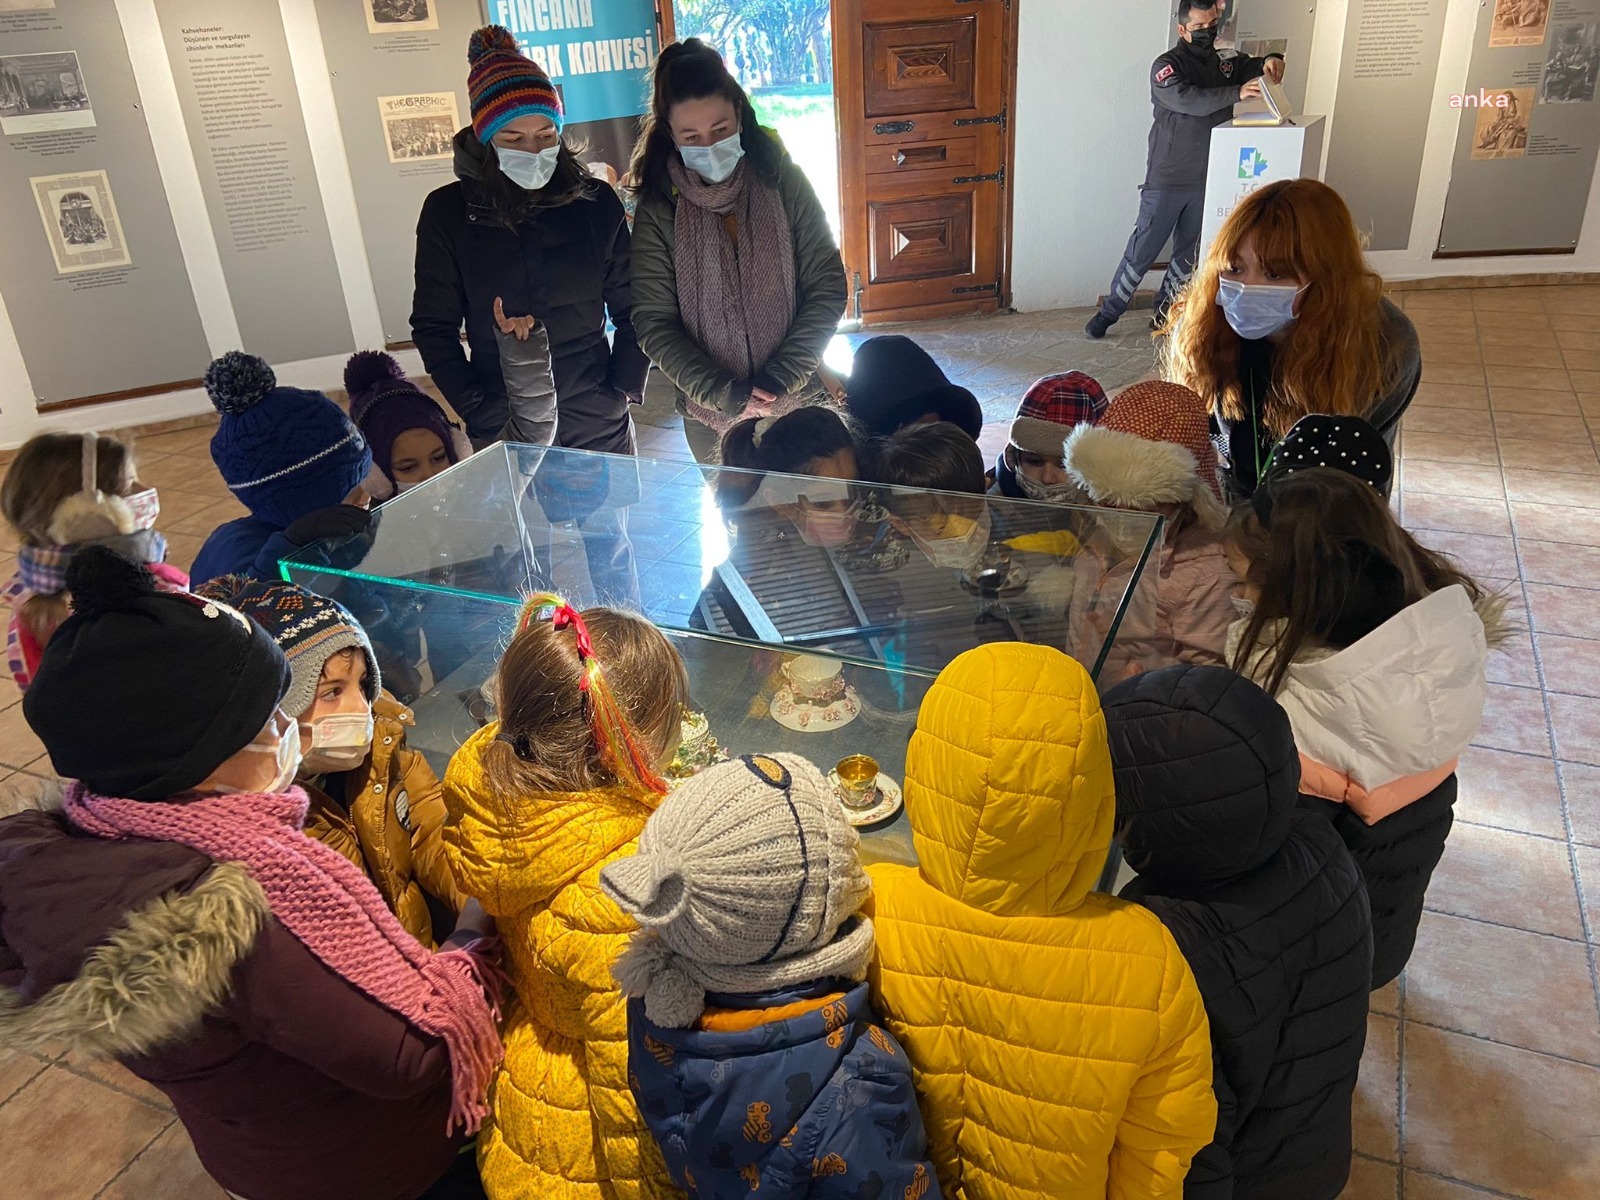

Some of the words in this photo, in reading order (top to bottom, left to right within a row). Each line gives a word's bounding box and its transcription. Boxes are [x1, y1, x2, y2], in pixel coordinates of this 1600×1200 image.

[183, 36, 211, 44] Düşünen
[219, 33, 251, 42] sorgulayan
[186, 44, 213, 52] zihinlerin
[567, 29, 654, 76] KAHVESİ
